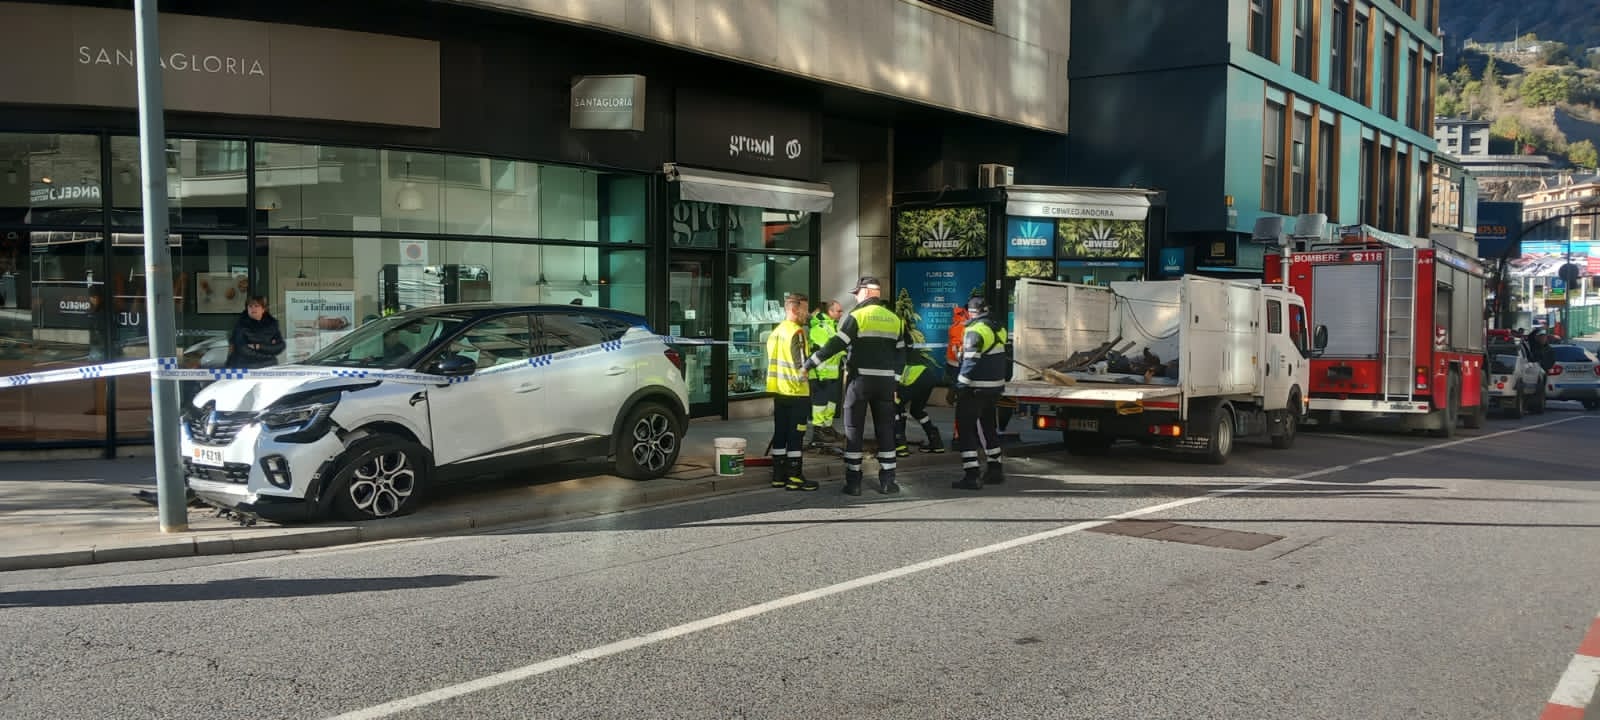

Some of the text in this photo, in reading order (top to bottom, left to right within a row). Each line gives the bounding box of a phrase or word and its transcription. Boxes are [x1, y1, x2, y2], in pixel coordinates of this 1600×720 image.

[79, 46, 265, 76] SANGLORIA
[575, 97, 632, 107] SANTAGLORIA
[729, 135, 775, 157] gresol
[1011, 238, 1048, 247] CBWEED
[1083, 239, 1120, 248] CBWEED
[1294, 252, 1383, 263] BOMBERS 118
